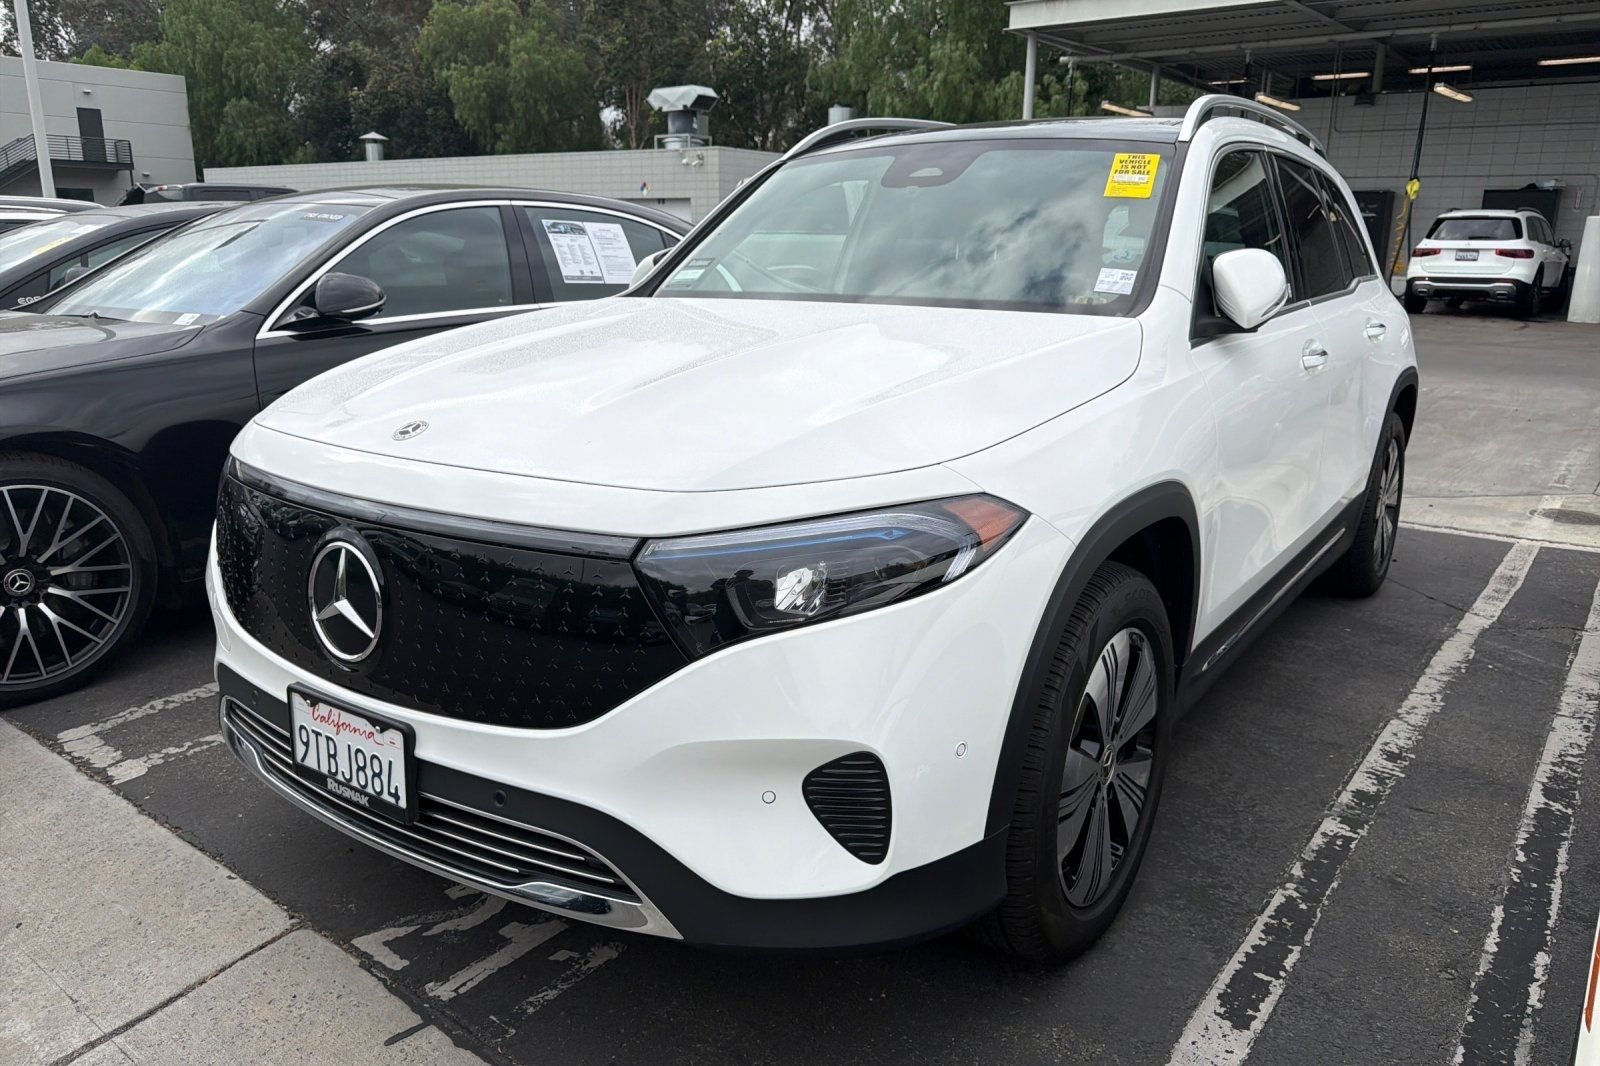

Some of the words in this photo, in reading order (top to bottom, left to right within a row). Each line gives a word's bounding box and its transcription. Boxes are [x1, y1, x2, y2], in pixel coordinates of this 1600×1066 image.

[311, 704, 384, 746] California
[298, 724, 401, 805] 9TBJ884
[327, 778, 370, 807] RUSNAK
